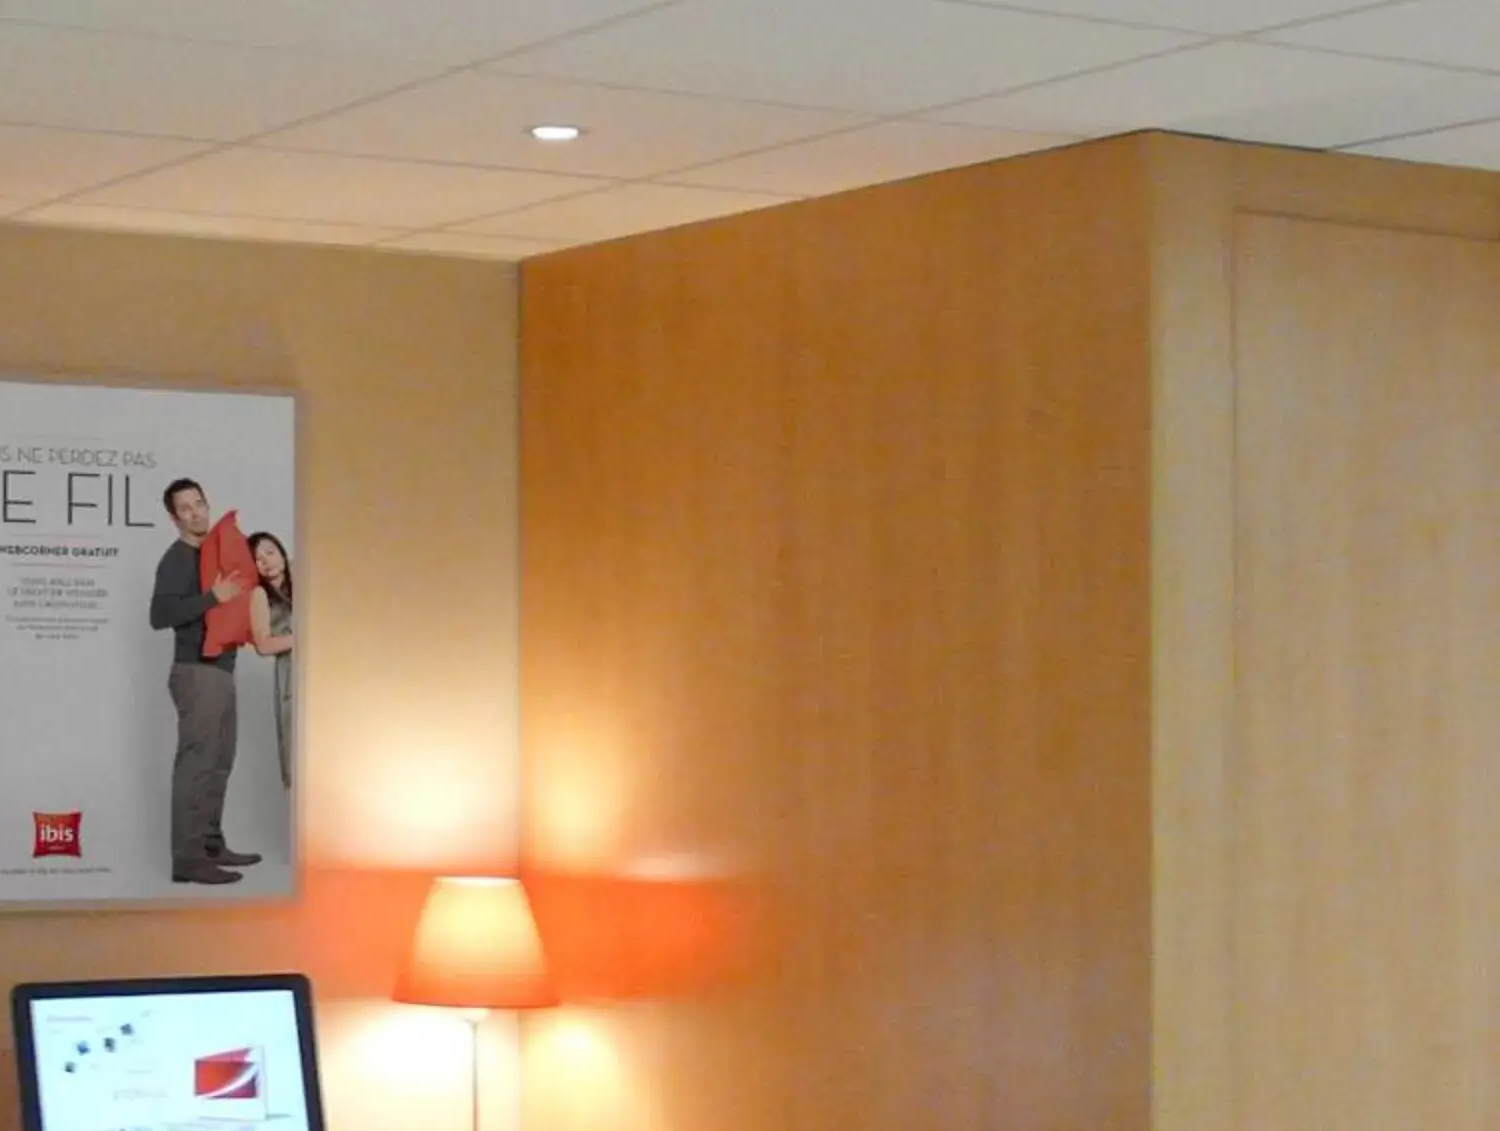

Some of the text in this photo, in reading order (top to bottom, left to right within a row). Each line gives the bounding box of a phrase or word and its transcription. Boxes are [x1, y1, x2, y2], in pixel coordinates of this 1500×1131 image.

[17, 447, 44, 464] NE
[48, 447, 118, 467] PERDEZ
[122, 450, 157, 469] PAS
[67, 471, 156, 528] FIL
[39, 822, 74, 843] ibis
